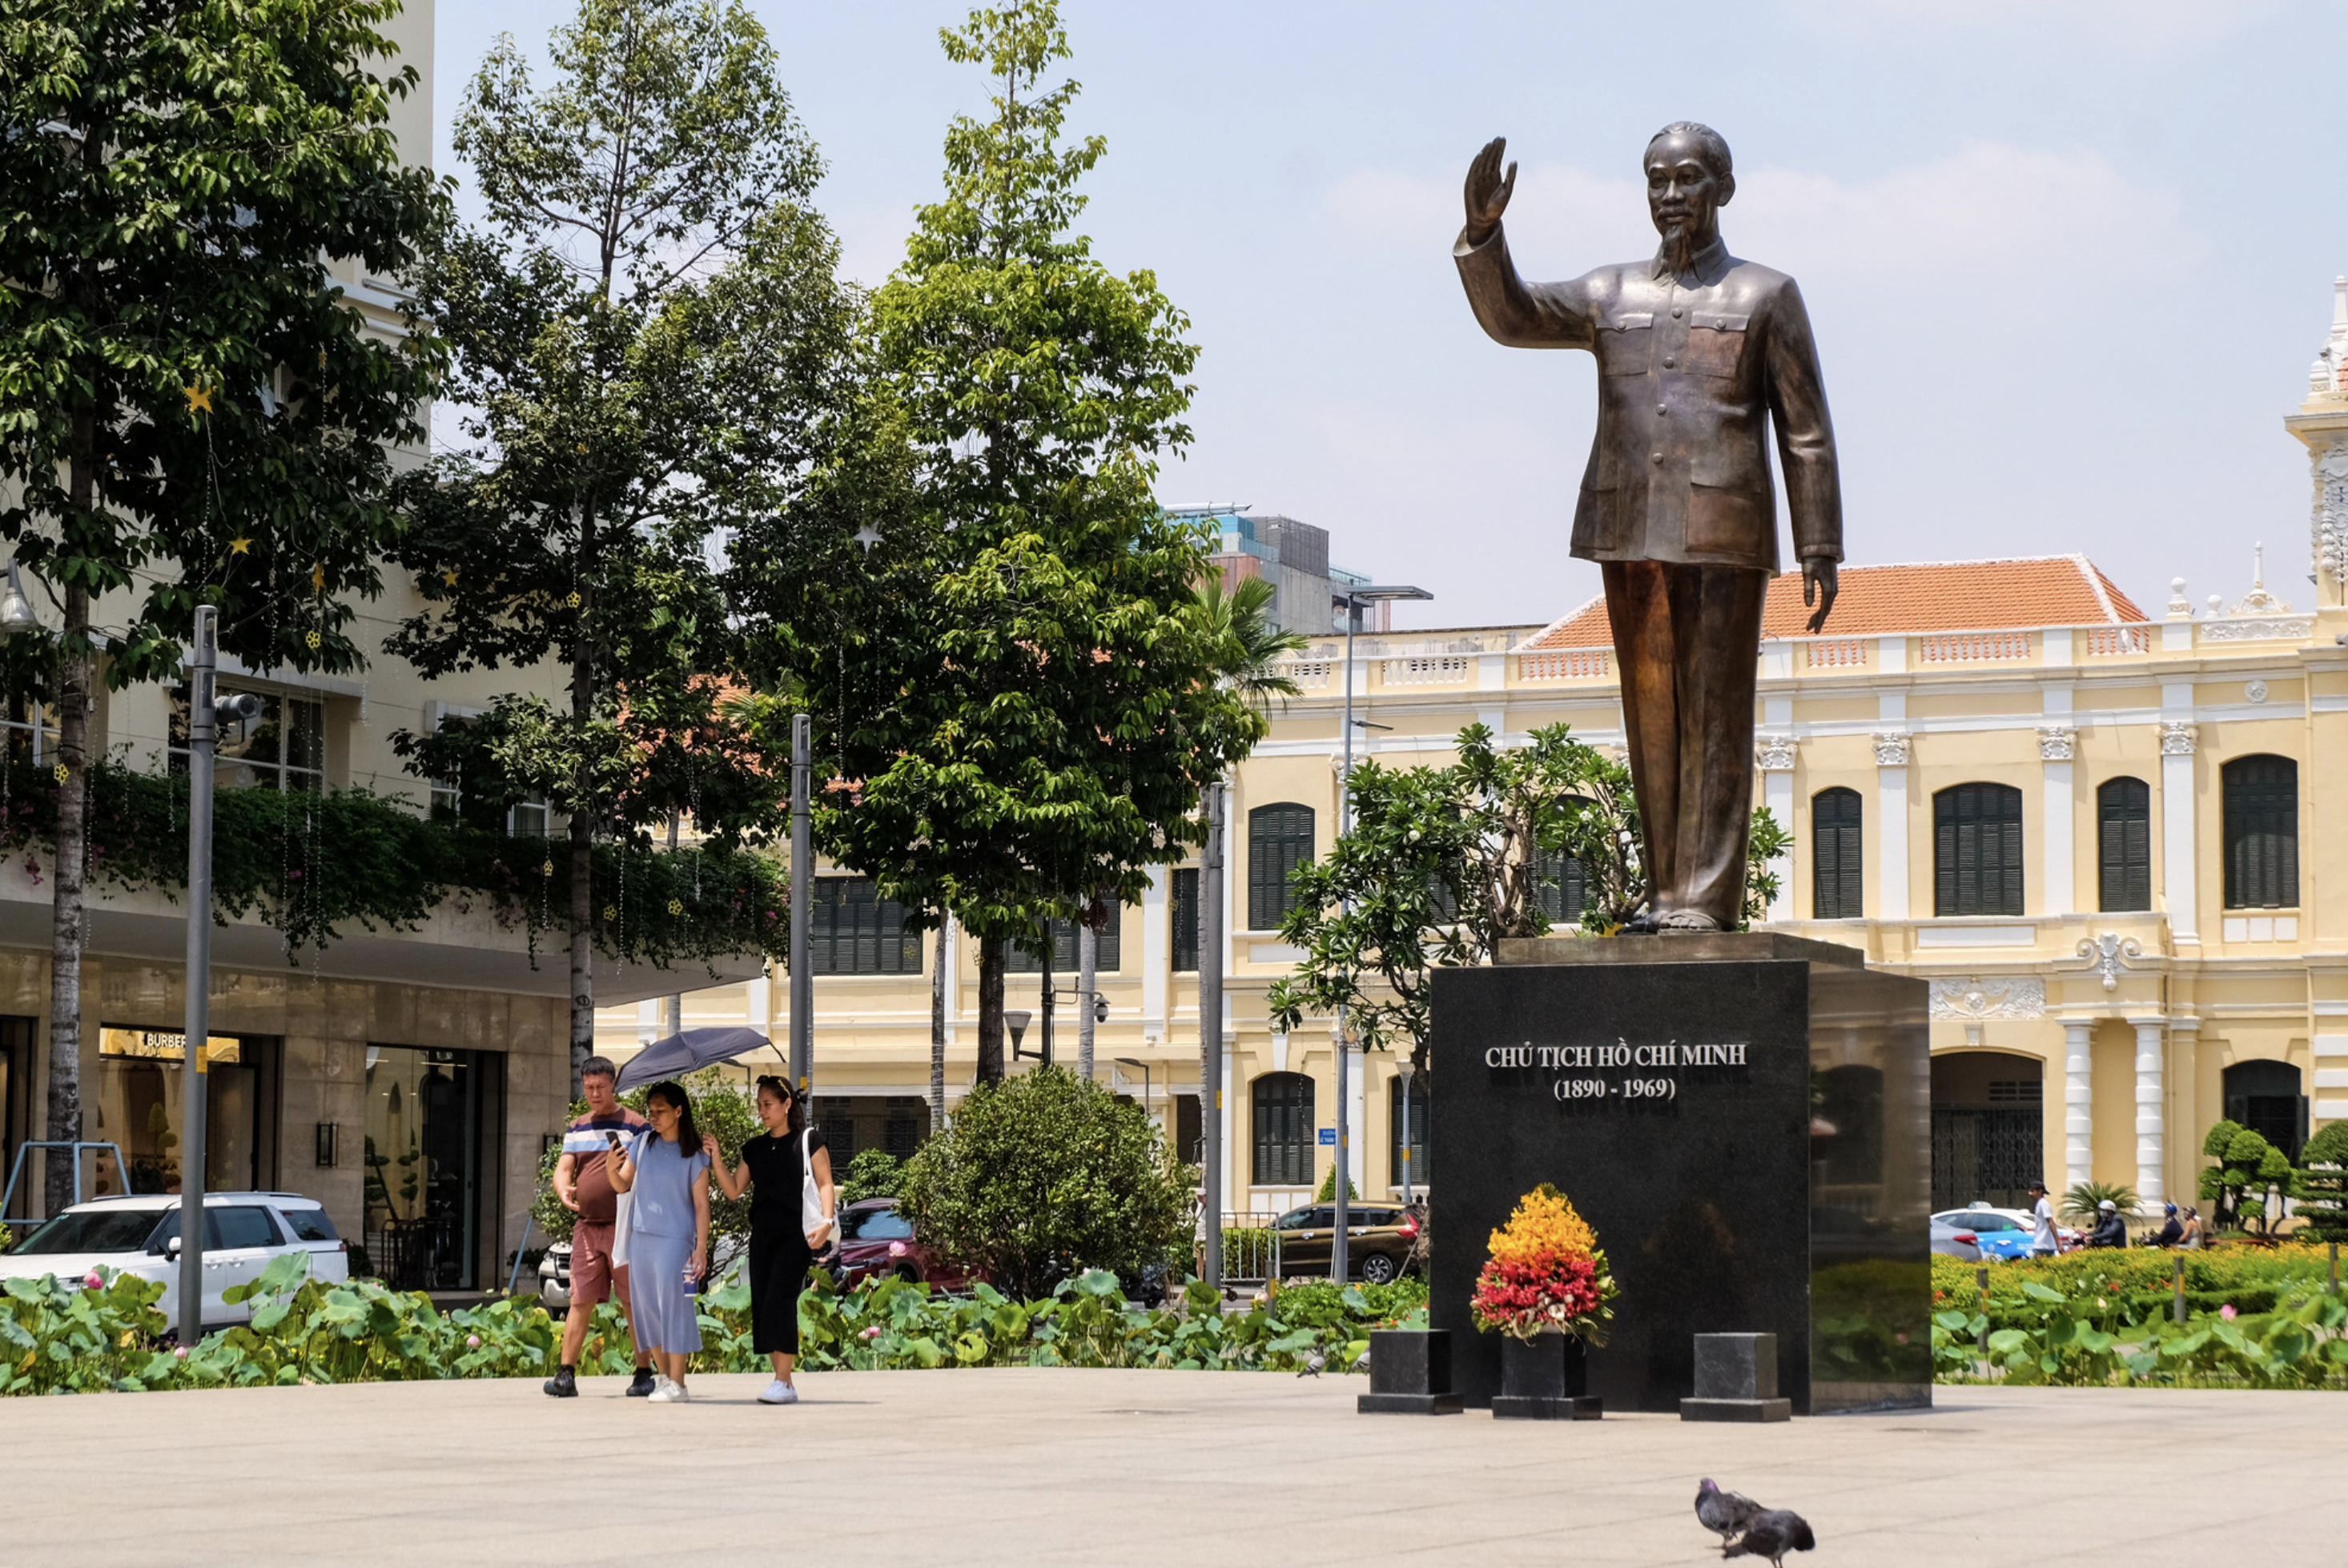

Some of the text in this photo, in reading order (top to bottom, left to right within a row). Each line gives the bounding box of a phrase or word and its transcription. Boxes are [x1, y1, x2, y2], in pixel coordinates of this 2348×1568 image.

[1485, 1037, 1747, 1070] CHỦ TỊCH HỒ CHÍ MINH
[1554, 1080, 1606, 1100] (1890
[1623, 1078, 1676, 1100] 1969)
